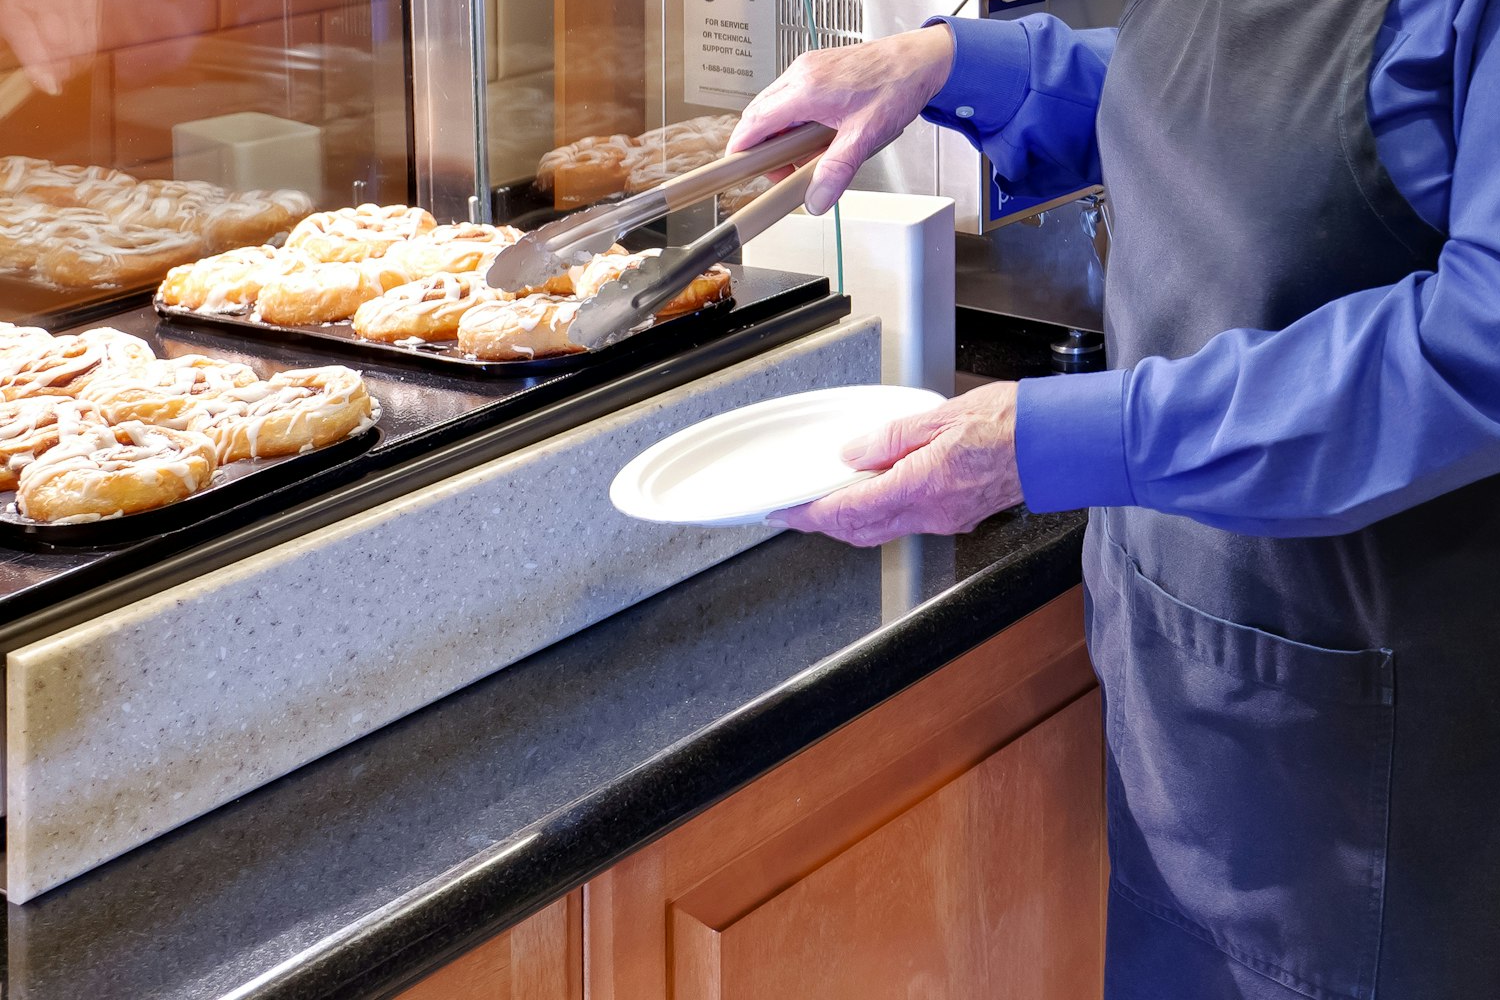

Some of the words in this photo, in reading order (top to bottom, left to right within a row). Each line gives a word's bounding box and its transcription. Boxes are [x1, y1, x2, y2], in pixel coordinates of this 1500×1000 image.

[705, 18, 718, 26] FOR
[720, 20, 749, 30] SERVICE
[714, 32, 752, 44] TECHNICAL
[702, 44, 733, 54] SUPPORT
[735, 48, 752, 57] CALL
